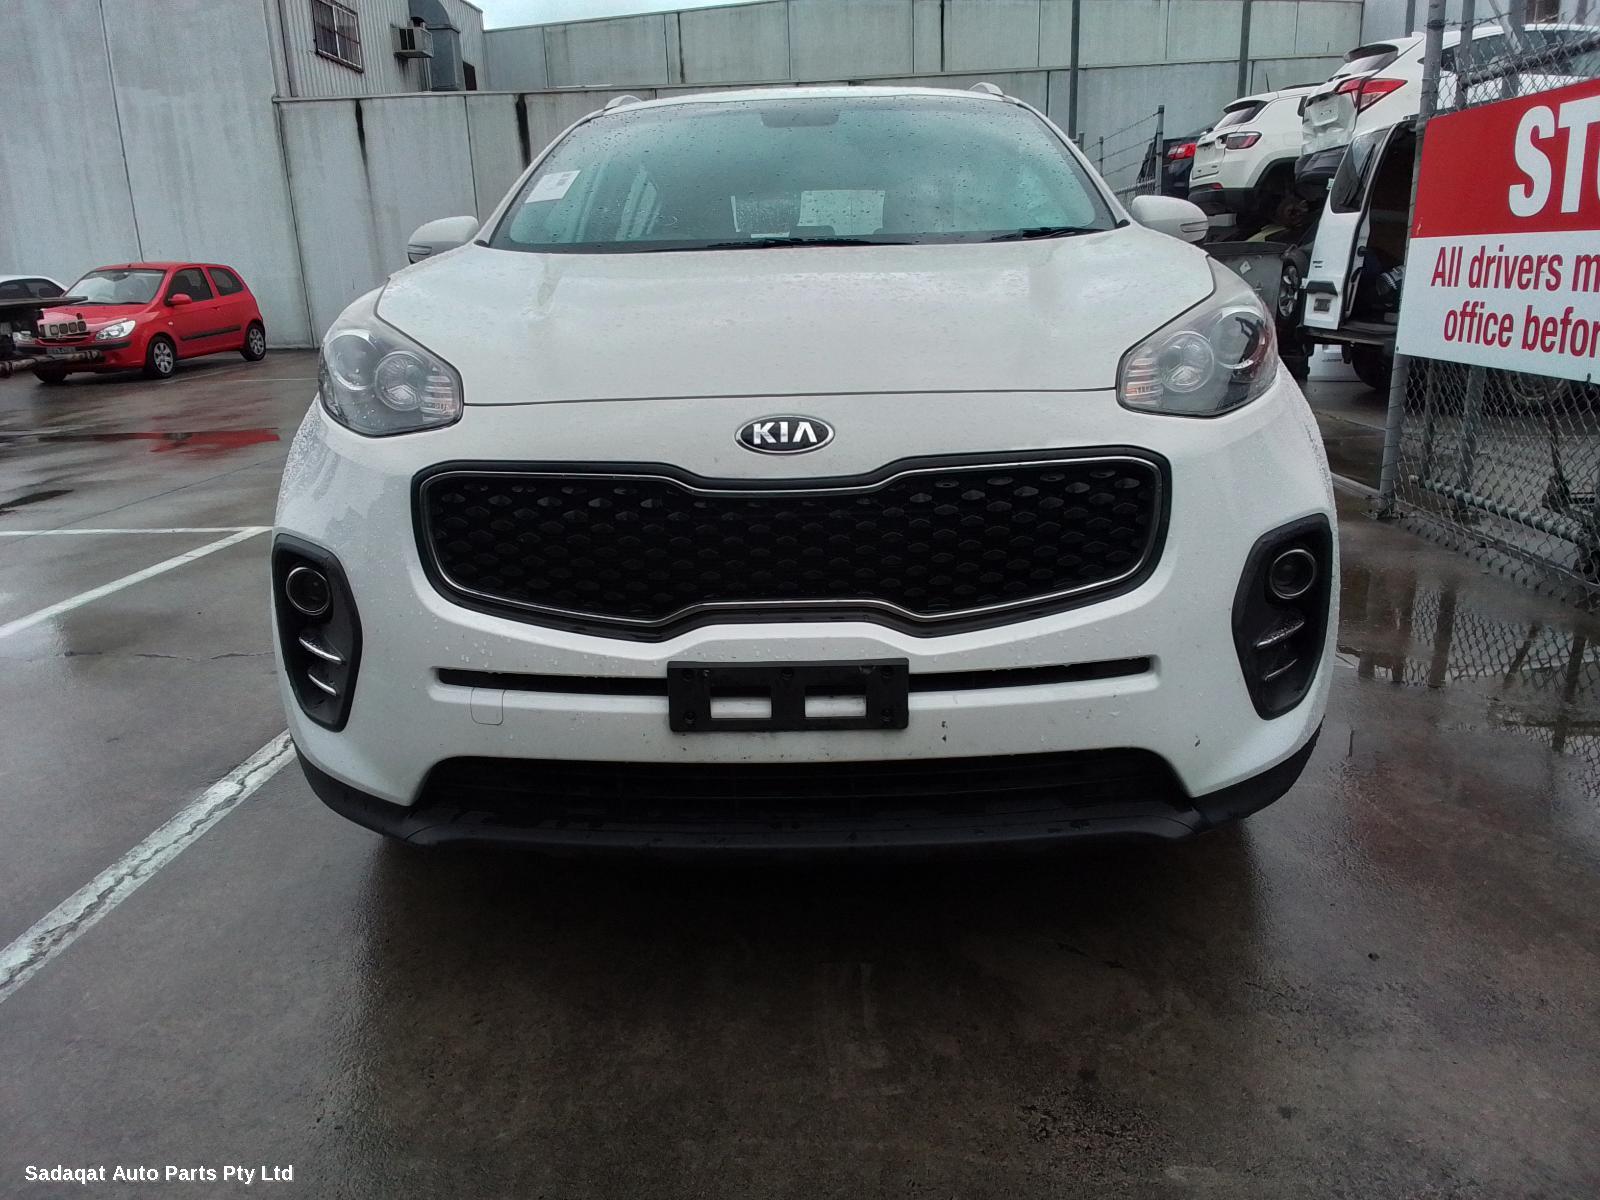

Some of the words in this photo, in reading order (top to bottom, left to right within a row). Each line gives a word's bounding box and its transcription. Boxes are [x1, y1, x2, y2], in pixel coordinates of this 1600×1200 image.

[1508, 96, 1600, 217] ST
[1431, 246, 1462, 287] All
[1468, 244, 1562, 291] drivers
[1444, 300, 1513, 347] office
[753, 421, 818, 445] KIA
